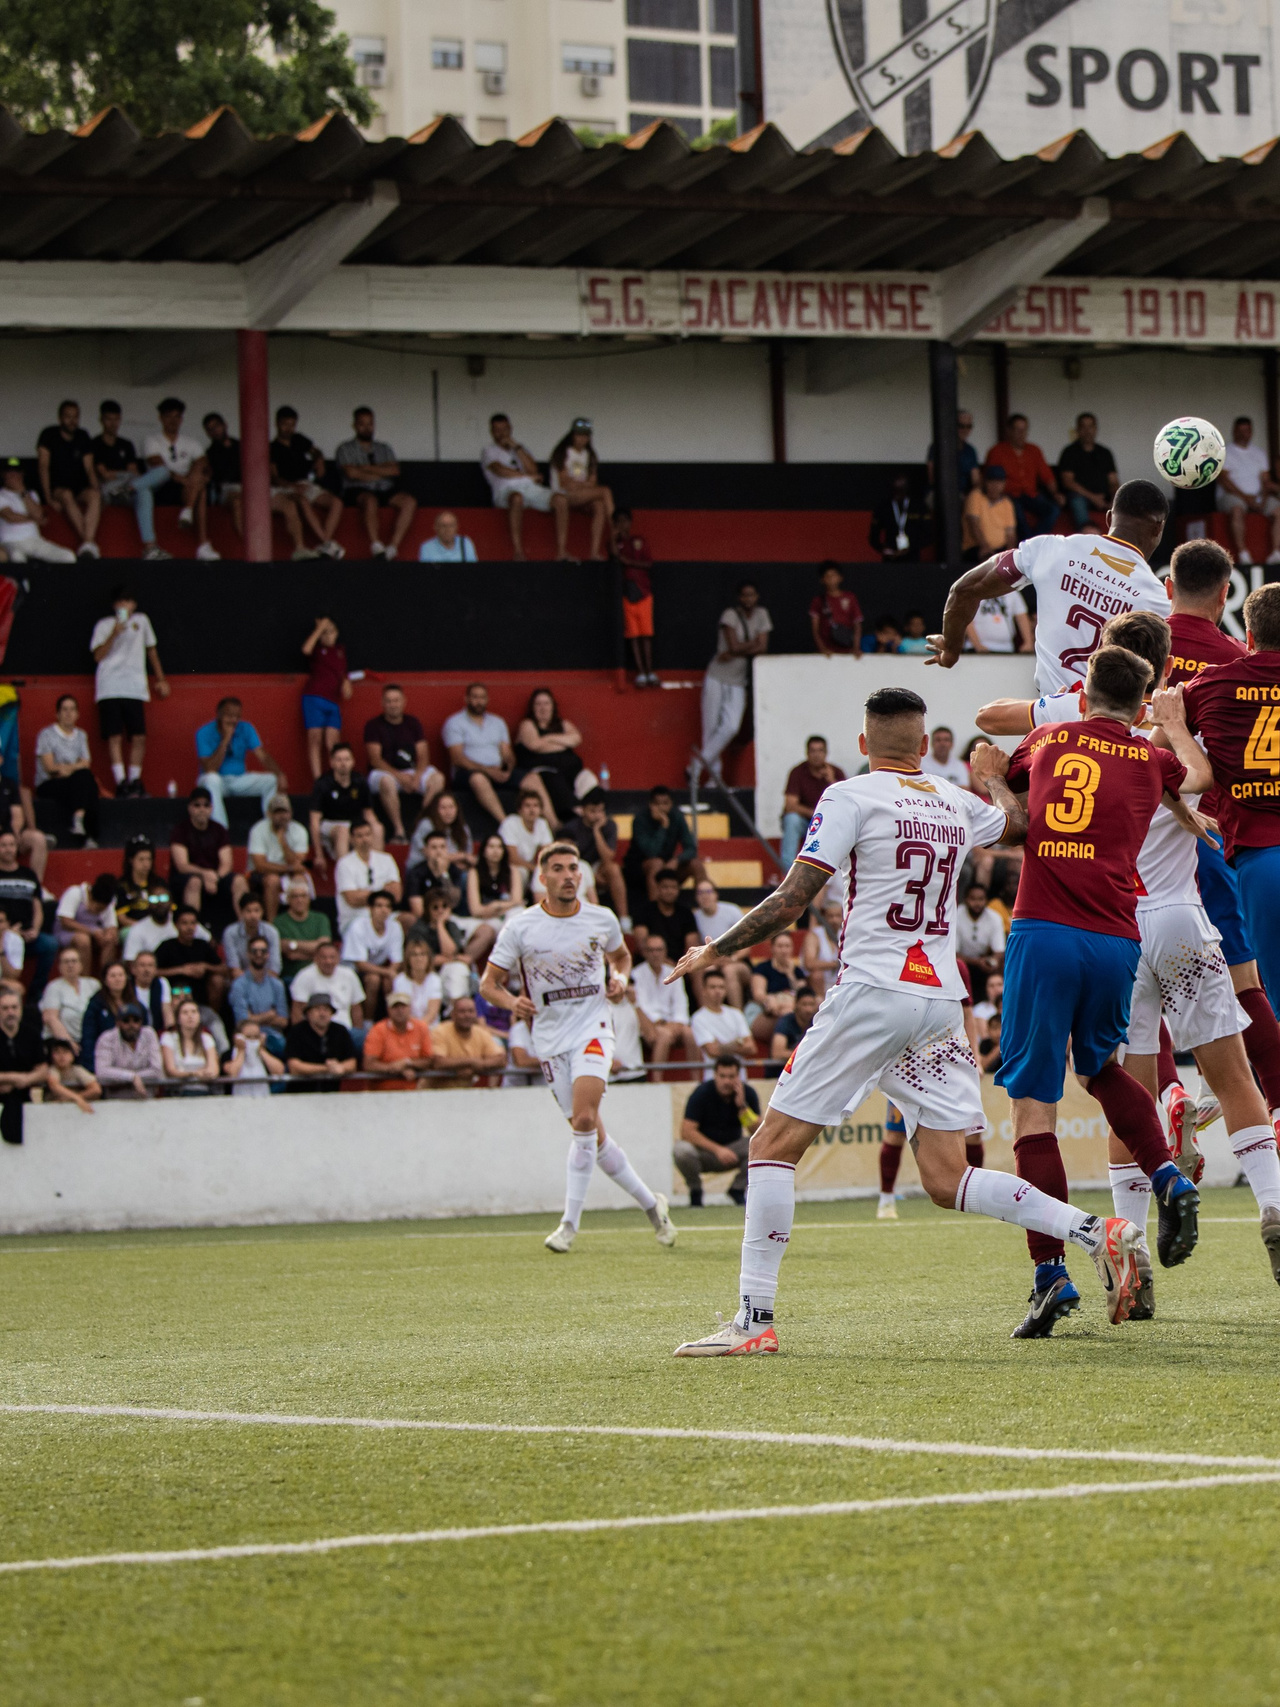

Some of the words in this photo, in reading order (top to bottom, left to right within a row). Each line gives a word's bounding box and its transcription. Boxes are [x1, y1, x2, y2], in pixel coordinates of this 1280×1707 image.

[1026, 44, 1261, 115] SPORT
[588, 276, 654, 329] S.G.
[685, 278, 932, 333] SACAVENENSE
[1121, 288, 1206, 337] 1910
[1060, 573, 1134, 616] DERITSON
[1068, 560, 1141, 597] D'BACALHAU
[1077, 734, 1149, 762] FREITAS
[1045, 752, 1102, 834] 3
[1037, 840, 1095, 860] MARIA
[885, 840, 959, 937] 31
[909, 961, 934, 976] DELTA
